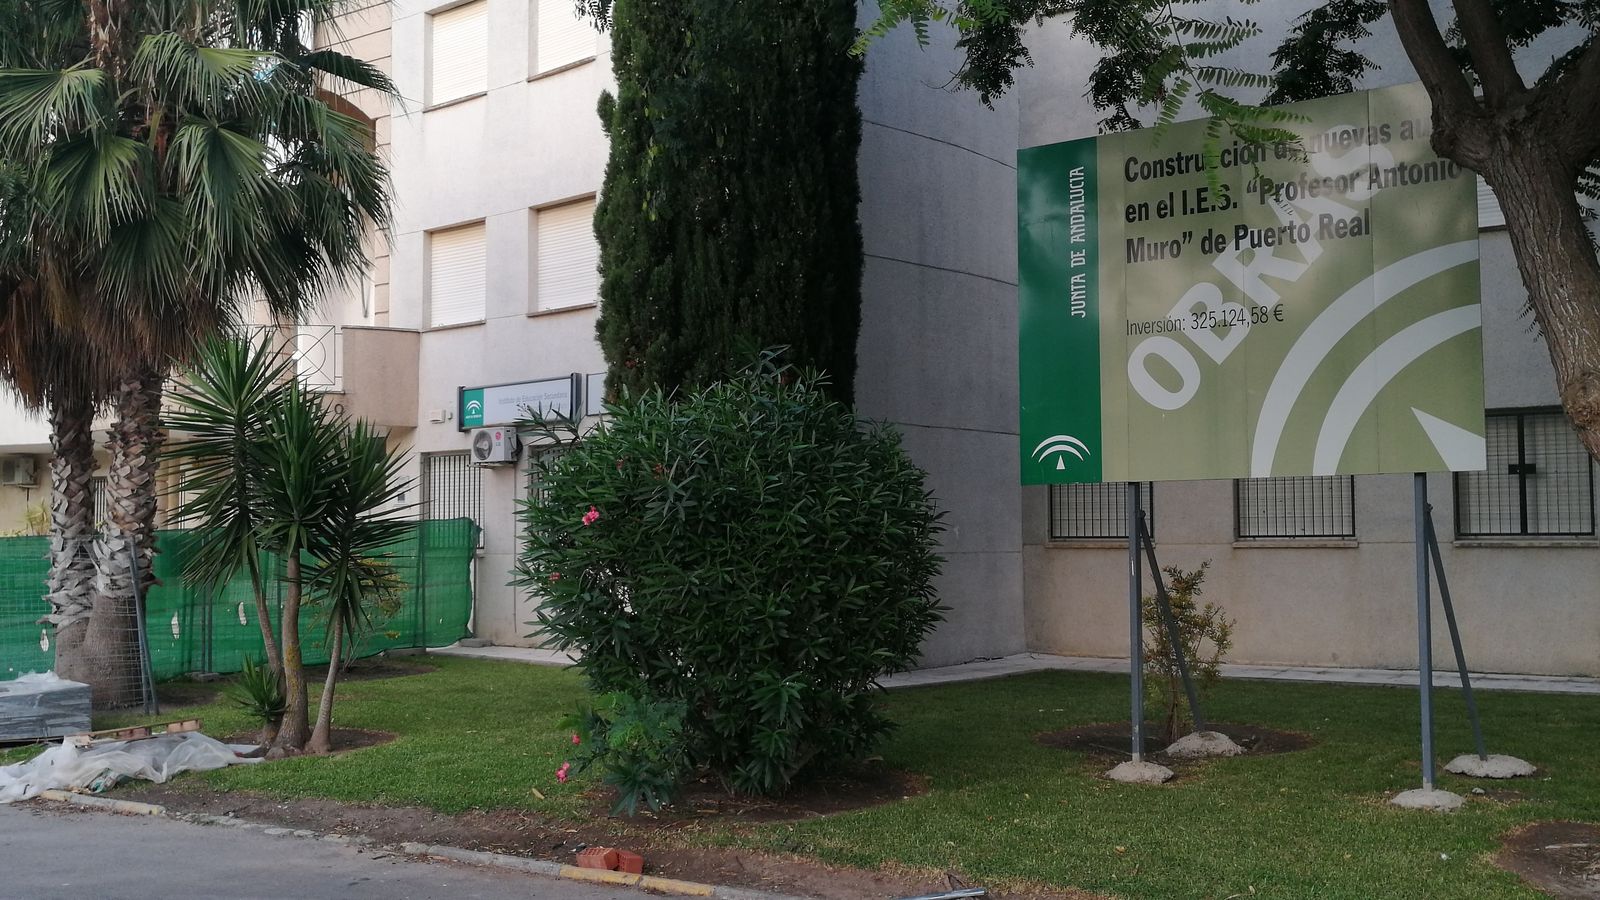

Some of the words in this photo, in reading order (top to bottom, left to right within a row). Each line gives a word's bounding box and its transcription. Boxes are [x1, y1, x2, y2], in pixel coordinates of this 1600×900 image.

[1309, 123, 1393, 156] nuevas
[1125, 200, 1150, 223] en
[1156, 191, 1175, 218] el
[1182, 184, 1238, 215] I.E.S.
[1367, 160, 1462, 191] Antonio
[1201, 228, 1227, 255] de
[1234, 220, 1311, 251] Puerto
[1318, 208, 1370, 241] Real
[1070, 248, 1086, 268] DE
[1127, 125, 1395, 411] OBRAS
[1071, 273, 1086, 318] JUNTA
[1126, 315, 1186, 336] Inversión:
[1190, 305, 1269, 330] 325.124,58
[1273, 304, 1284, 322] €
